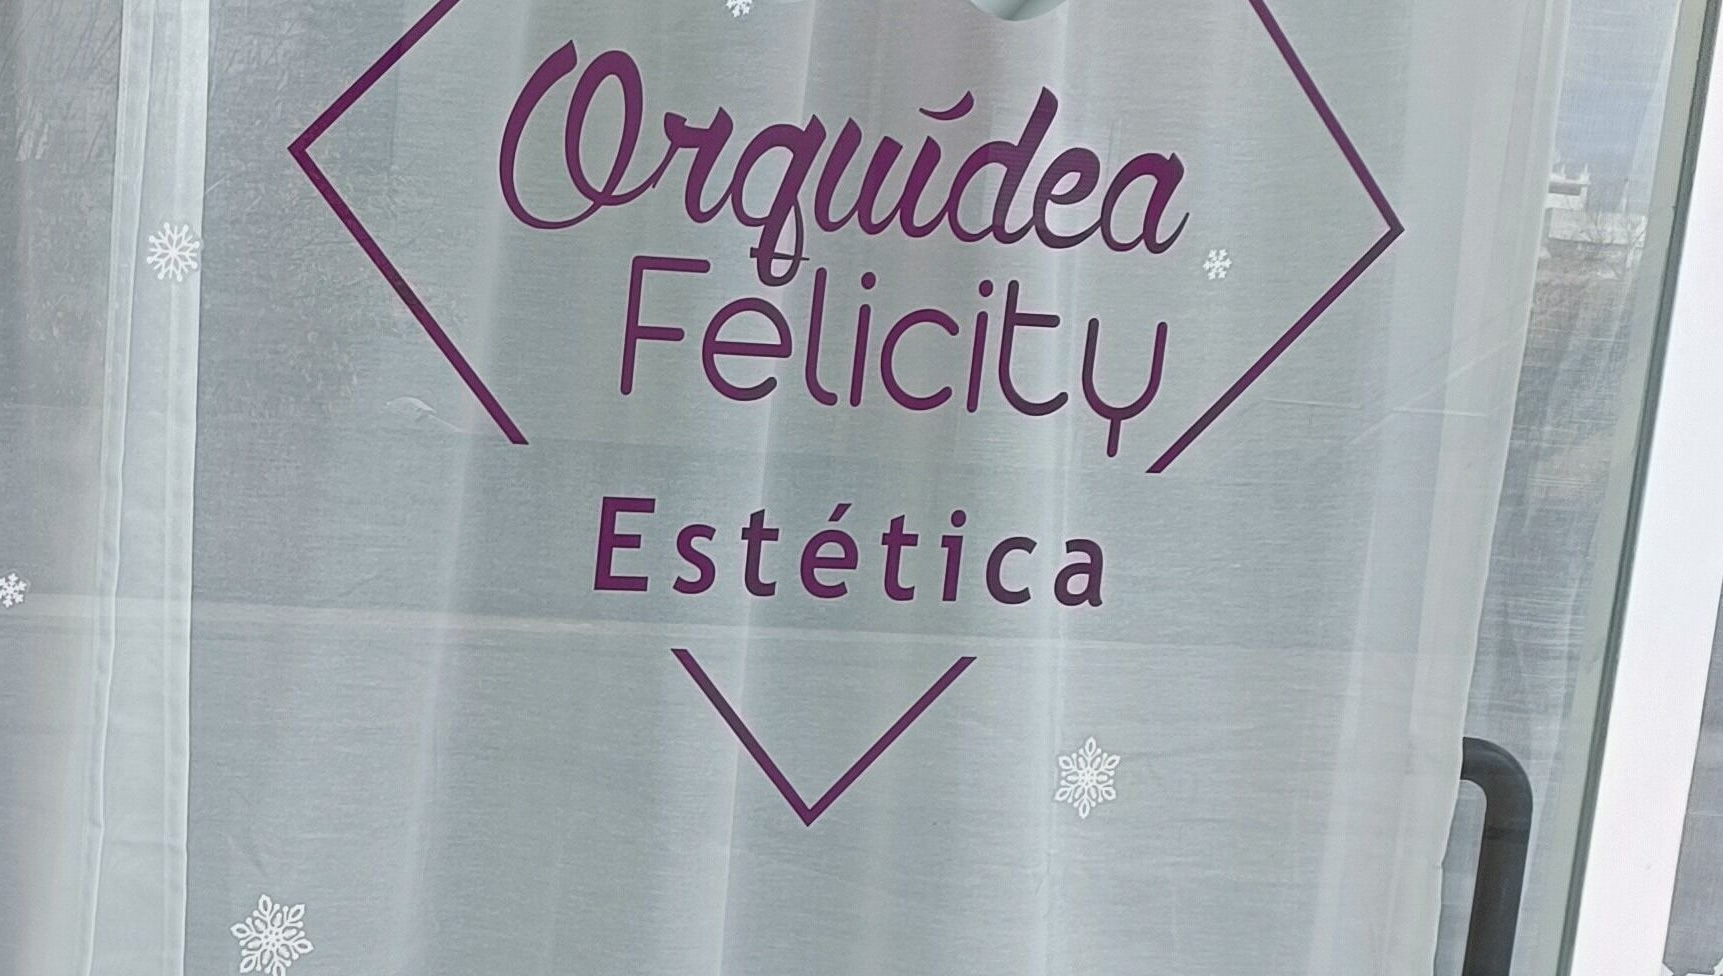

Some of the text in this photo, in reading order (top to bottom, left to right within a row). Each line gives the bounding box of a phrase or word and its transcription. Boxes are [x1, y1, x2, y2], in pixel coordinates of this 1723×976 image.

[498, 39, 1190, 286] Orquídea
[620, 254, 1169, 458] Felicity
[593, 495, 1106, 608] Estética
